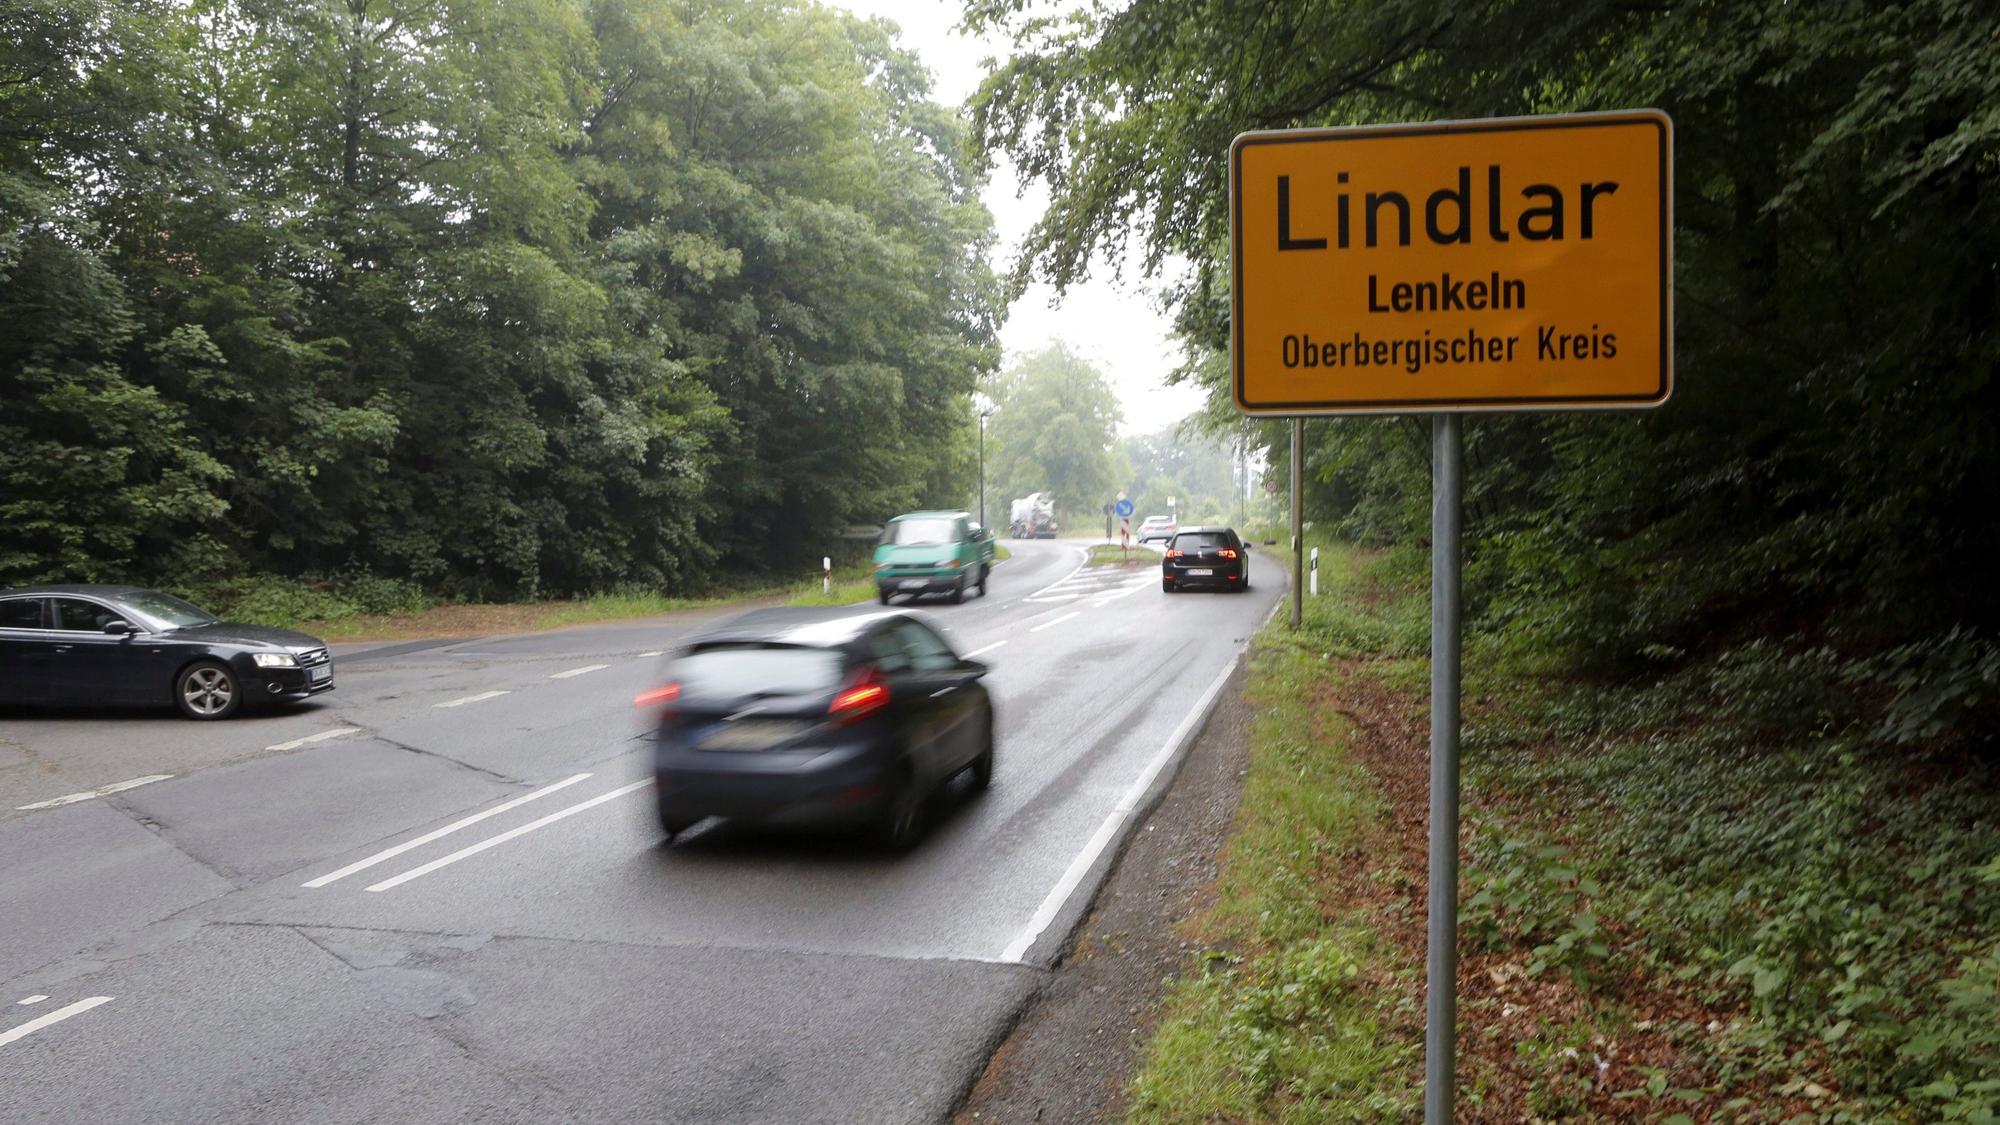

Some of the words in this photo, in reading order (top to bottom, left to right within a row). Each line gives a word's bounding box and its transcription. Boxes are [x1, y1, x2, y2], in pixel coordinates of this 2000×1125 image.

[1276, 163, 1621, 252] Lindlar
[1367, 271, 1527, 314] Lenkeln
[1282, 329, 1520, 375] Oberbergischer
[1536, 323, 1618, 363] Kreis
